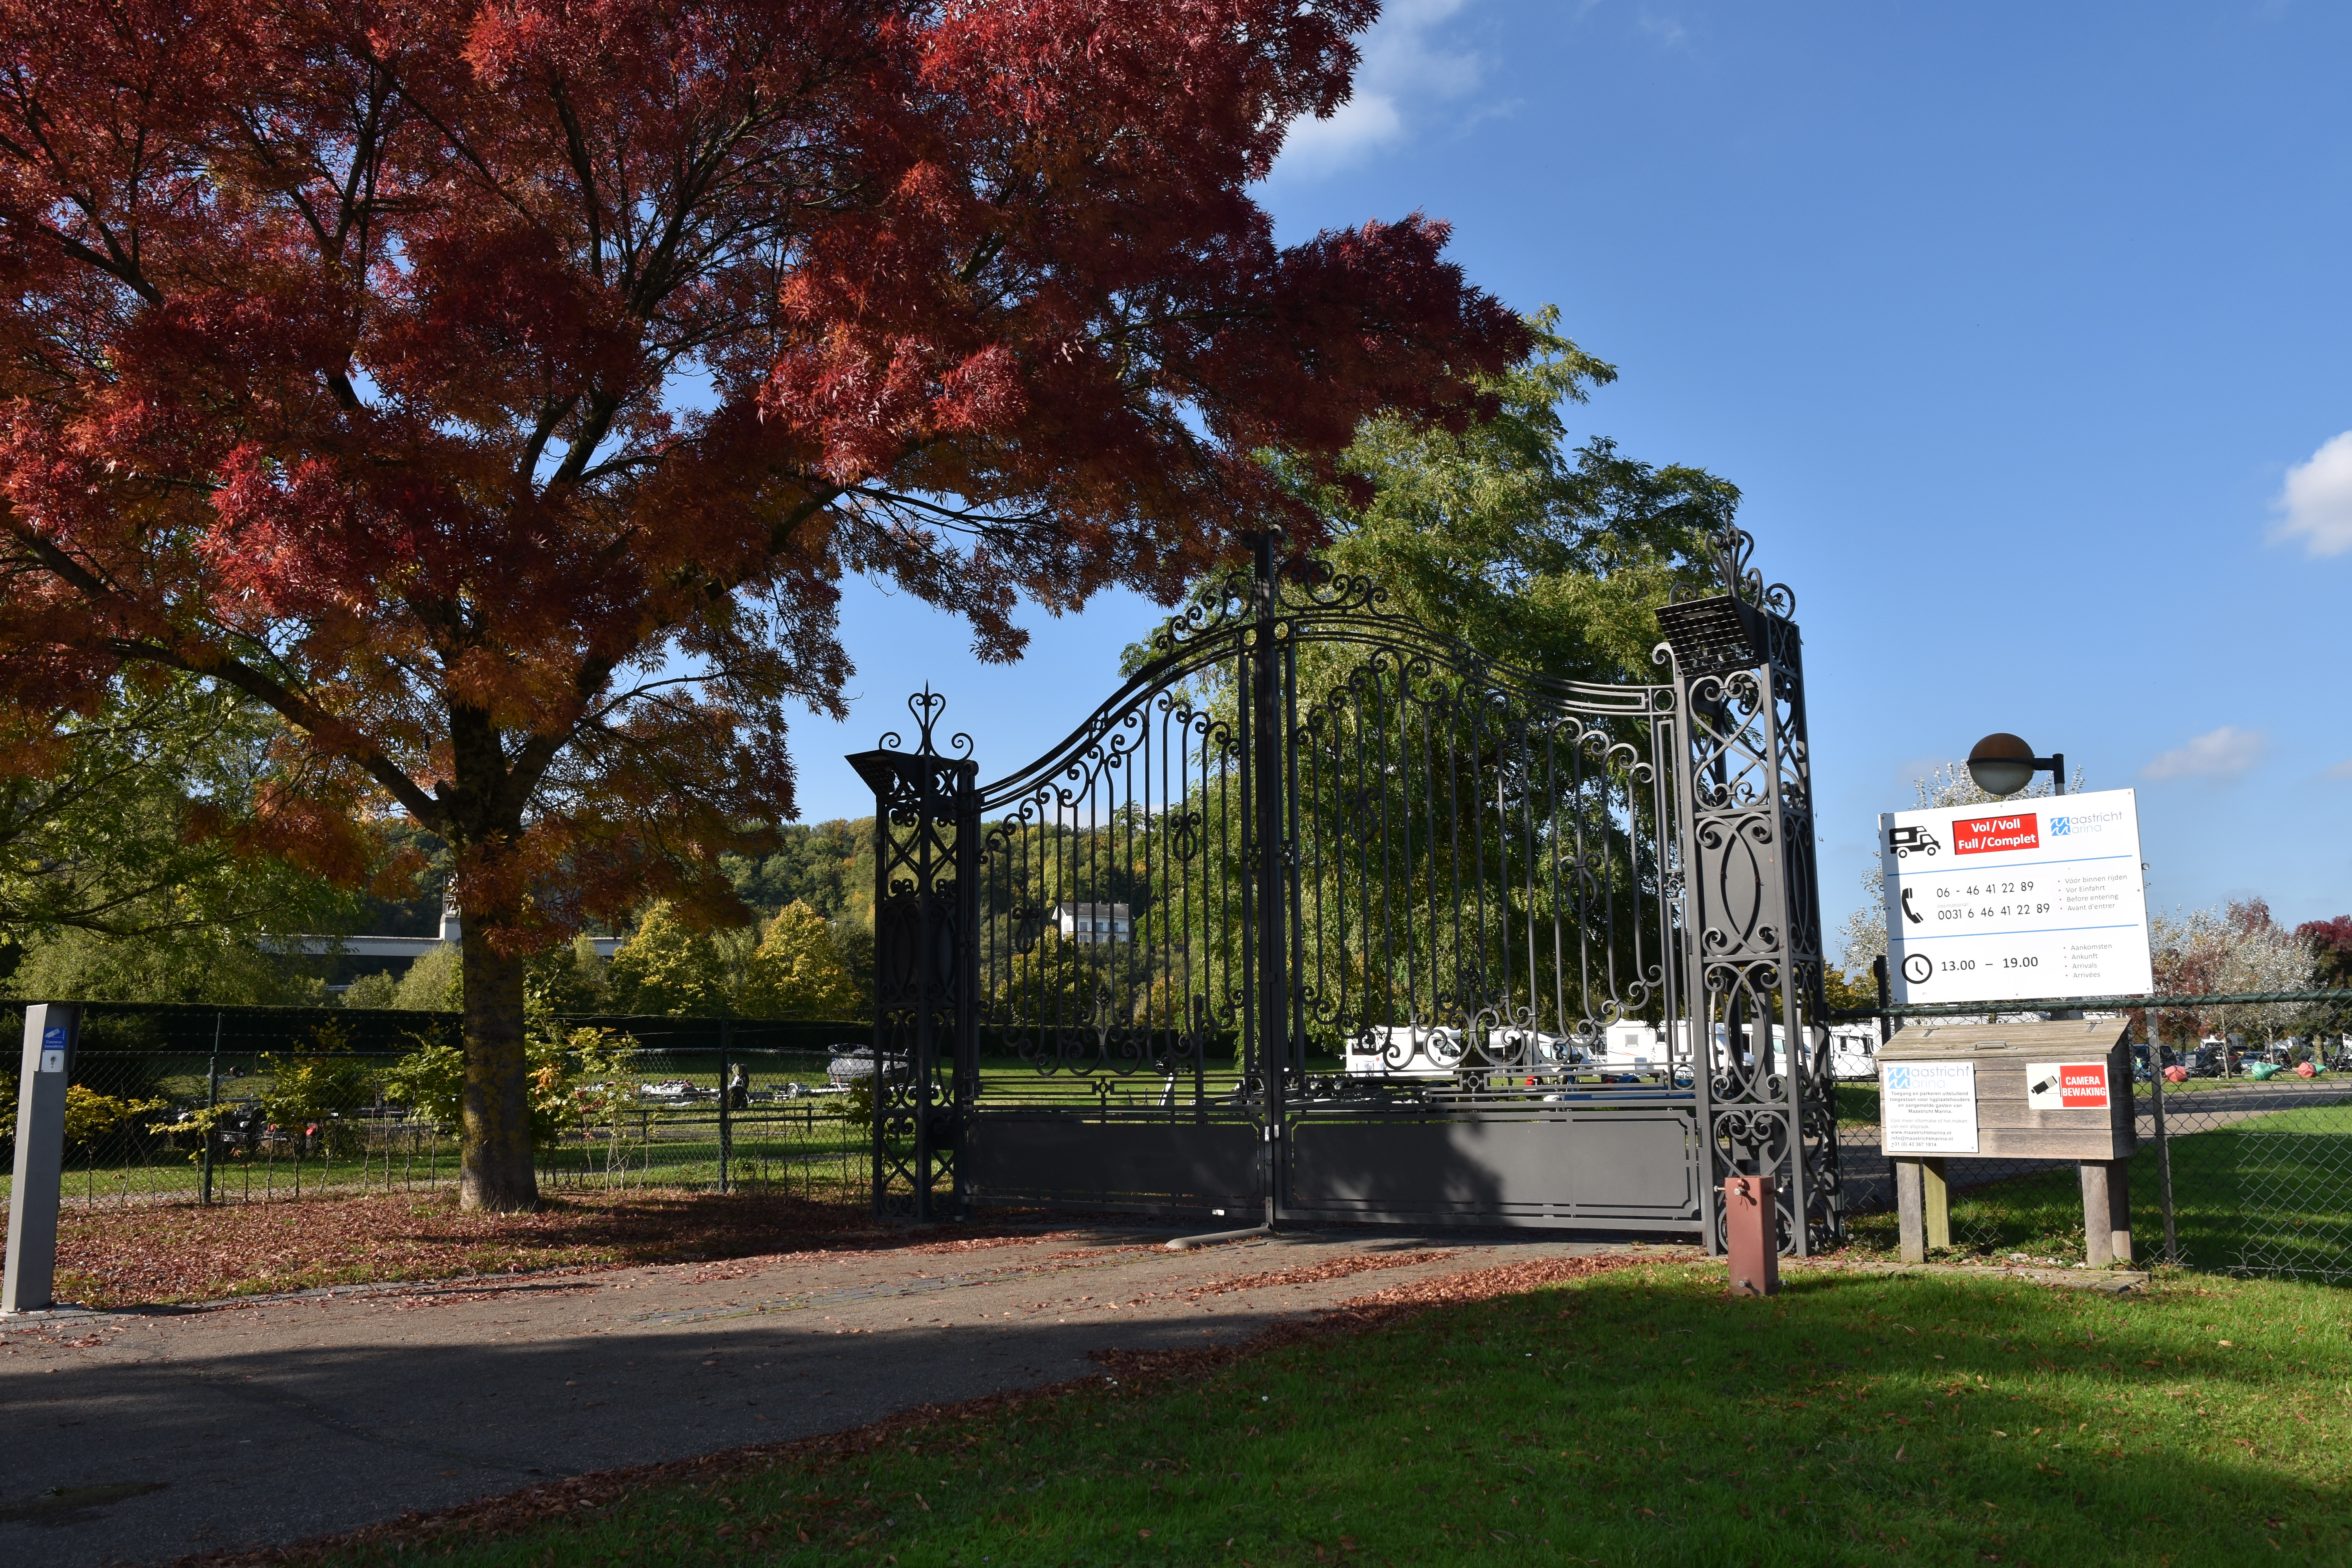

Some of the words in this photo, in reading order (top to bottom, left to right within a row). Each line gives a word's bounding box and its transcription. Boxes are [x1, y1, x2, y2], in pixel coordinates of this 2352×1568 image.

[1937, 888, 1950, 897] 06
[1966, 885, 1979, 895] 46
[1986, 884, 1995, 894] 41
[2002, 883, 2014, 893] 22
[2021, 881, 2034, 891] 89
[1938, 909, 1962, 920] 0031
[1968, 908, 1974, 918] 6
[1981, 907, 1994, 917] 46
[2001, 906, 2010, 915] 41
[2017, 904, 2030, 915] 22
[2037, 903, 2049, 913] 89
[1941, 960, 1975, 971] 13.00
[2003, 956, 2038, 968] 19.00
[2065, 1076, 2100, 1085] CAMERA
[2062, 1087, 2106, 1096] BEWAKING
